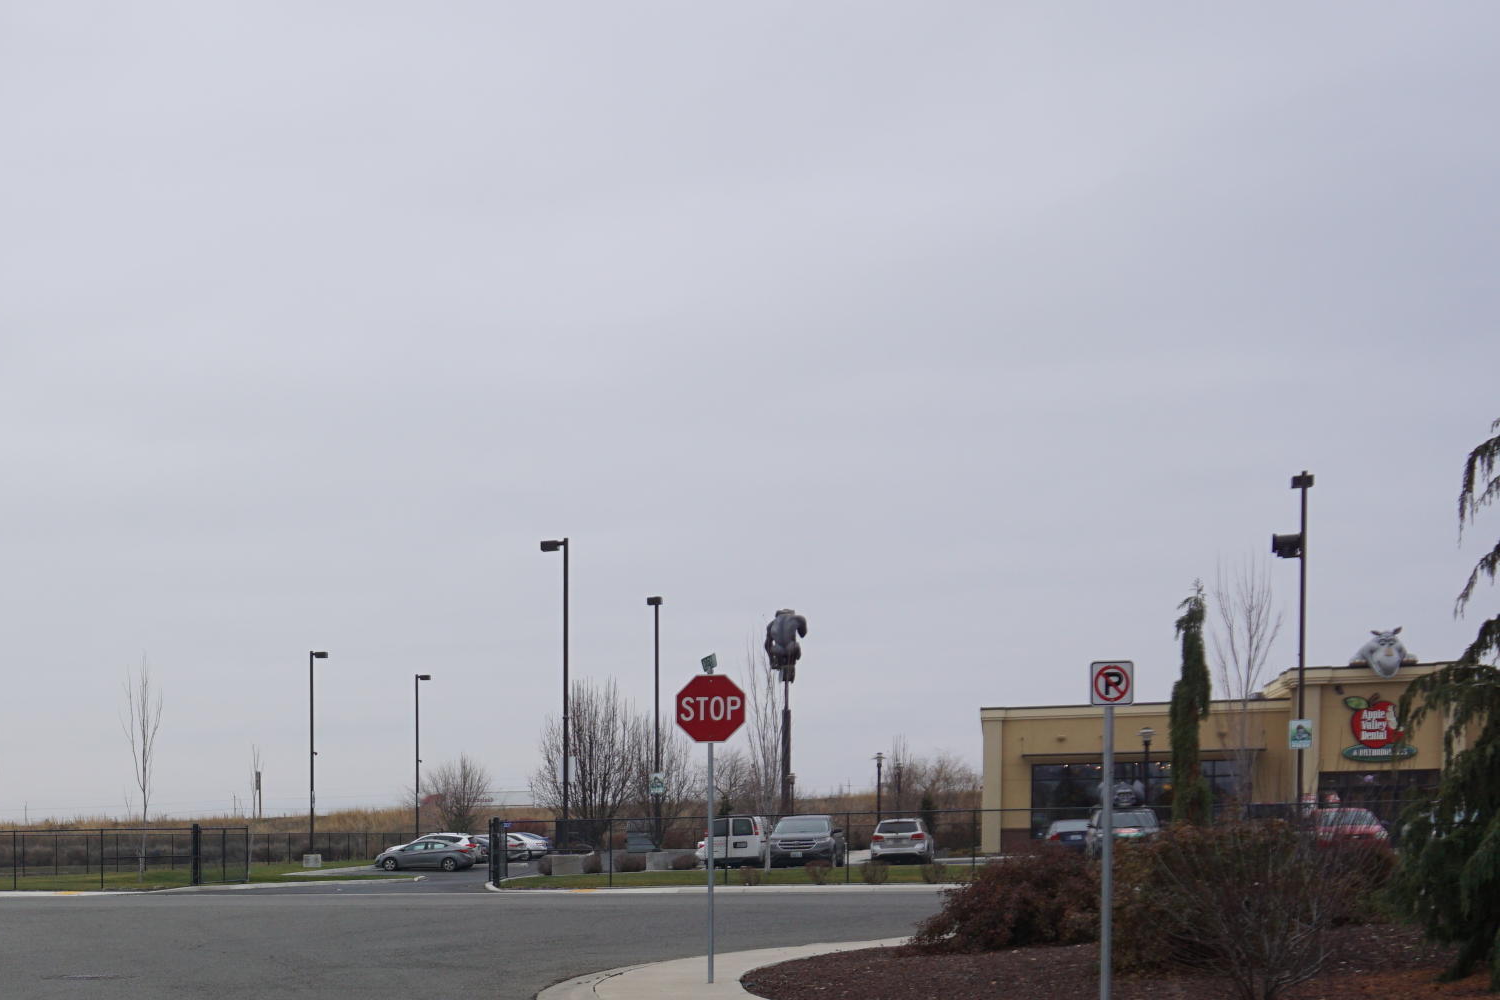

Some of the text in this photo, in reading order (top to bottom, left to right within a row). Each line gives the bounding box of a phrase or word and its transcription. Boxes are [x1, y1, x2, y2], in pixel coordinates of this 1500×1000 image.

[680, 696, 742, 721] STOP
[1362, 709, 1386, 720] Apple
[1361, 719, 1388, 731] Valley
[1361, 730, 1387, 740] Dental
